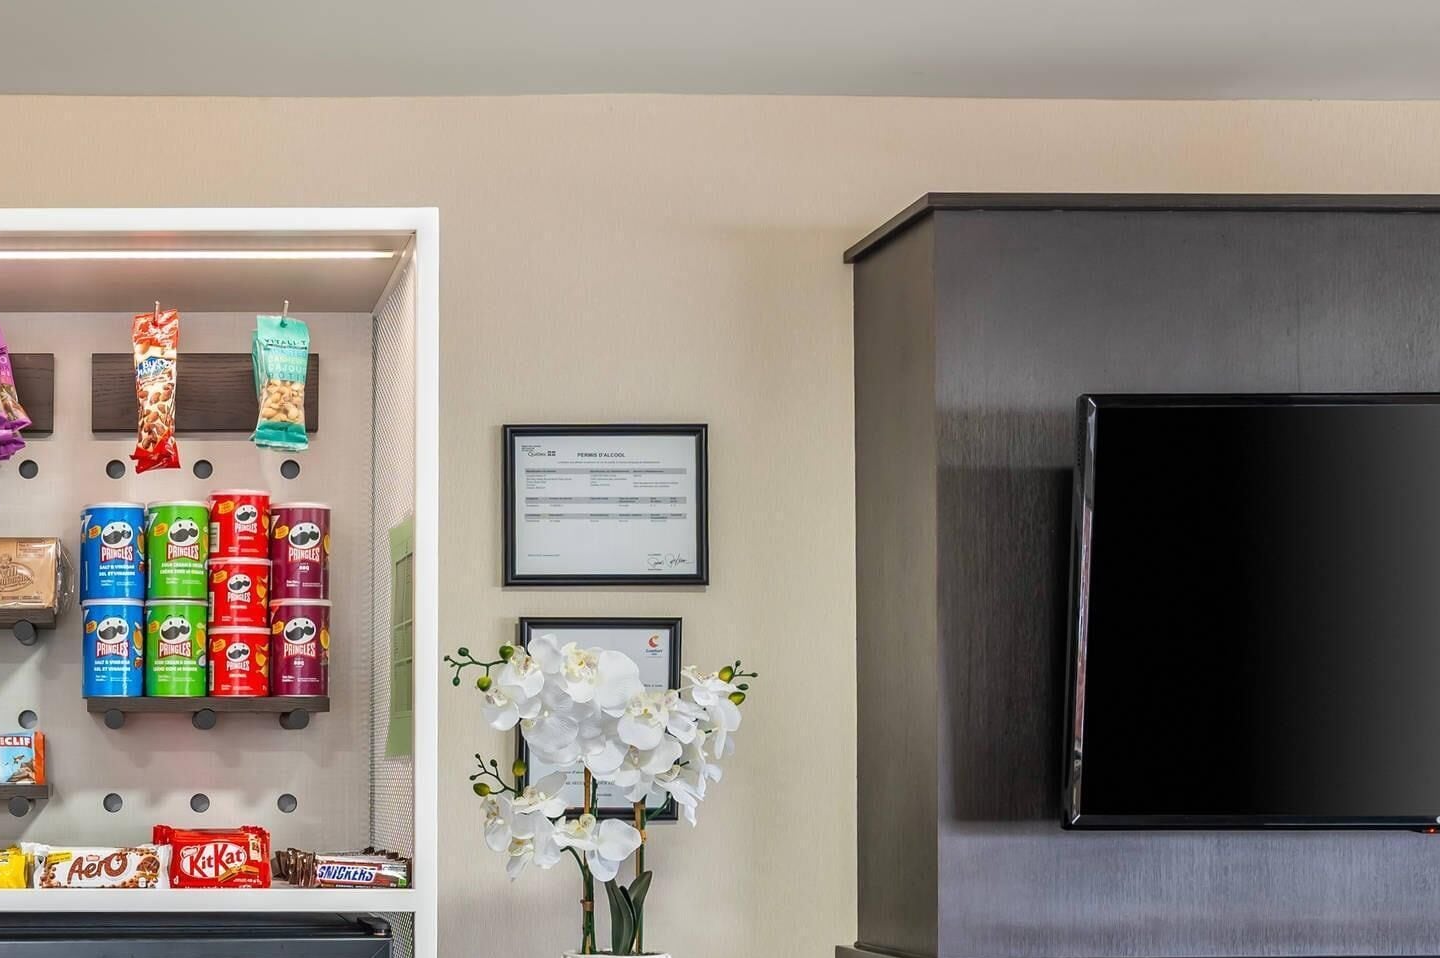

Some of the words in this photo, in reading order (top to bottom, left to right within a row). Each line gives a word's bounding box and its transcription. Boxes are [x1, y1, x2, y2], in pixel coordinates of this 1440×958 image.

[101, 545, 133, 562] PRINGLES
[167, 543, 199, 560] PRINGLES
[288, 547, 320, 563] PRINGLES
[96, 641, 129, 657] PRINGLES
[159, 641, 191, 657] PRINGLES
[284, 642, 316, 658] PRINGLES
[4, 737, 31, 746] CLIF
[318, 865, 376, 882] SNICKERS
